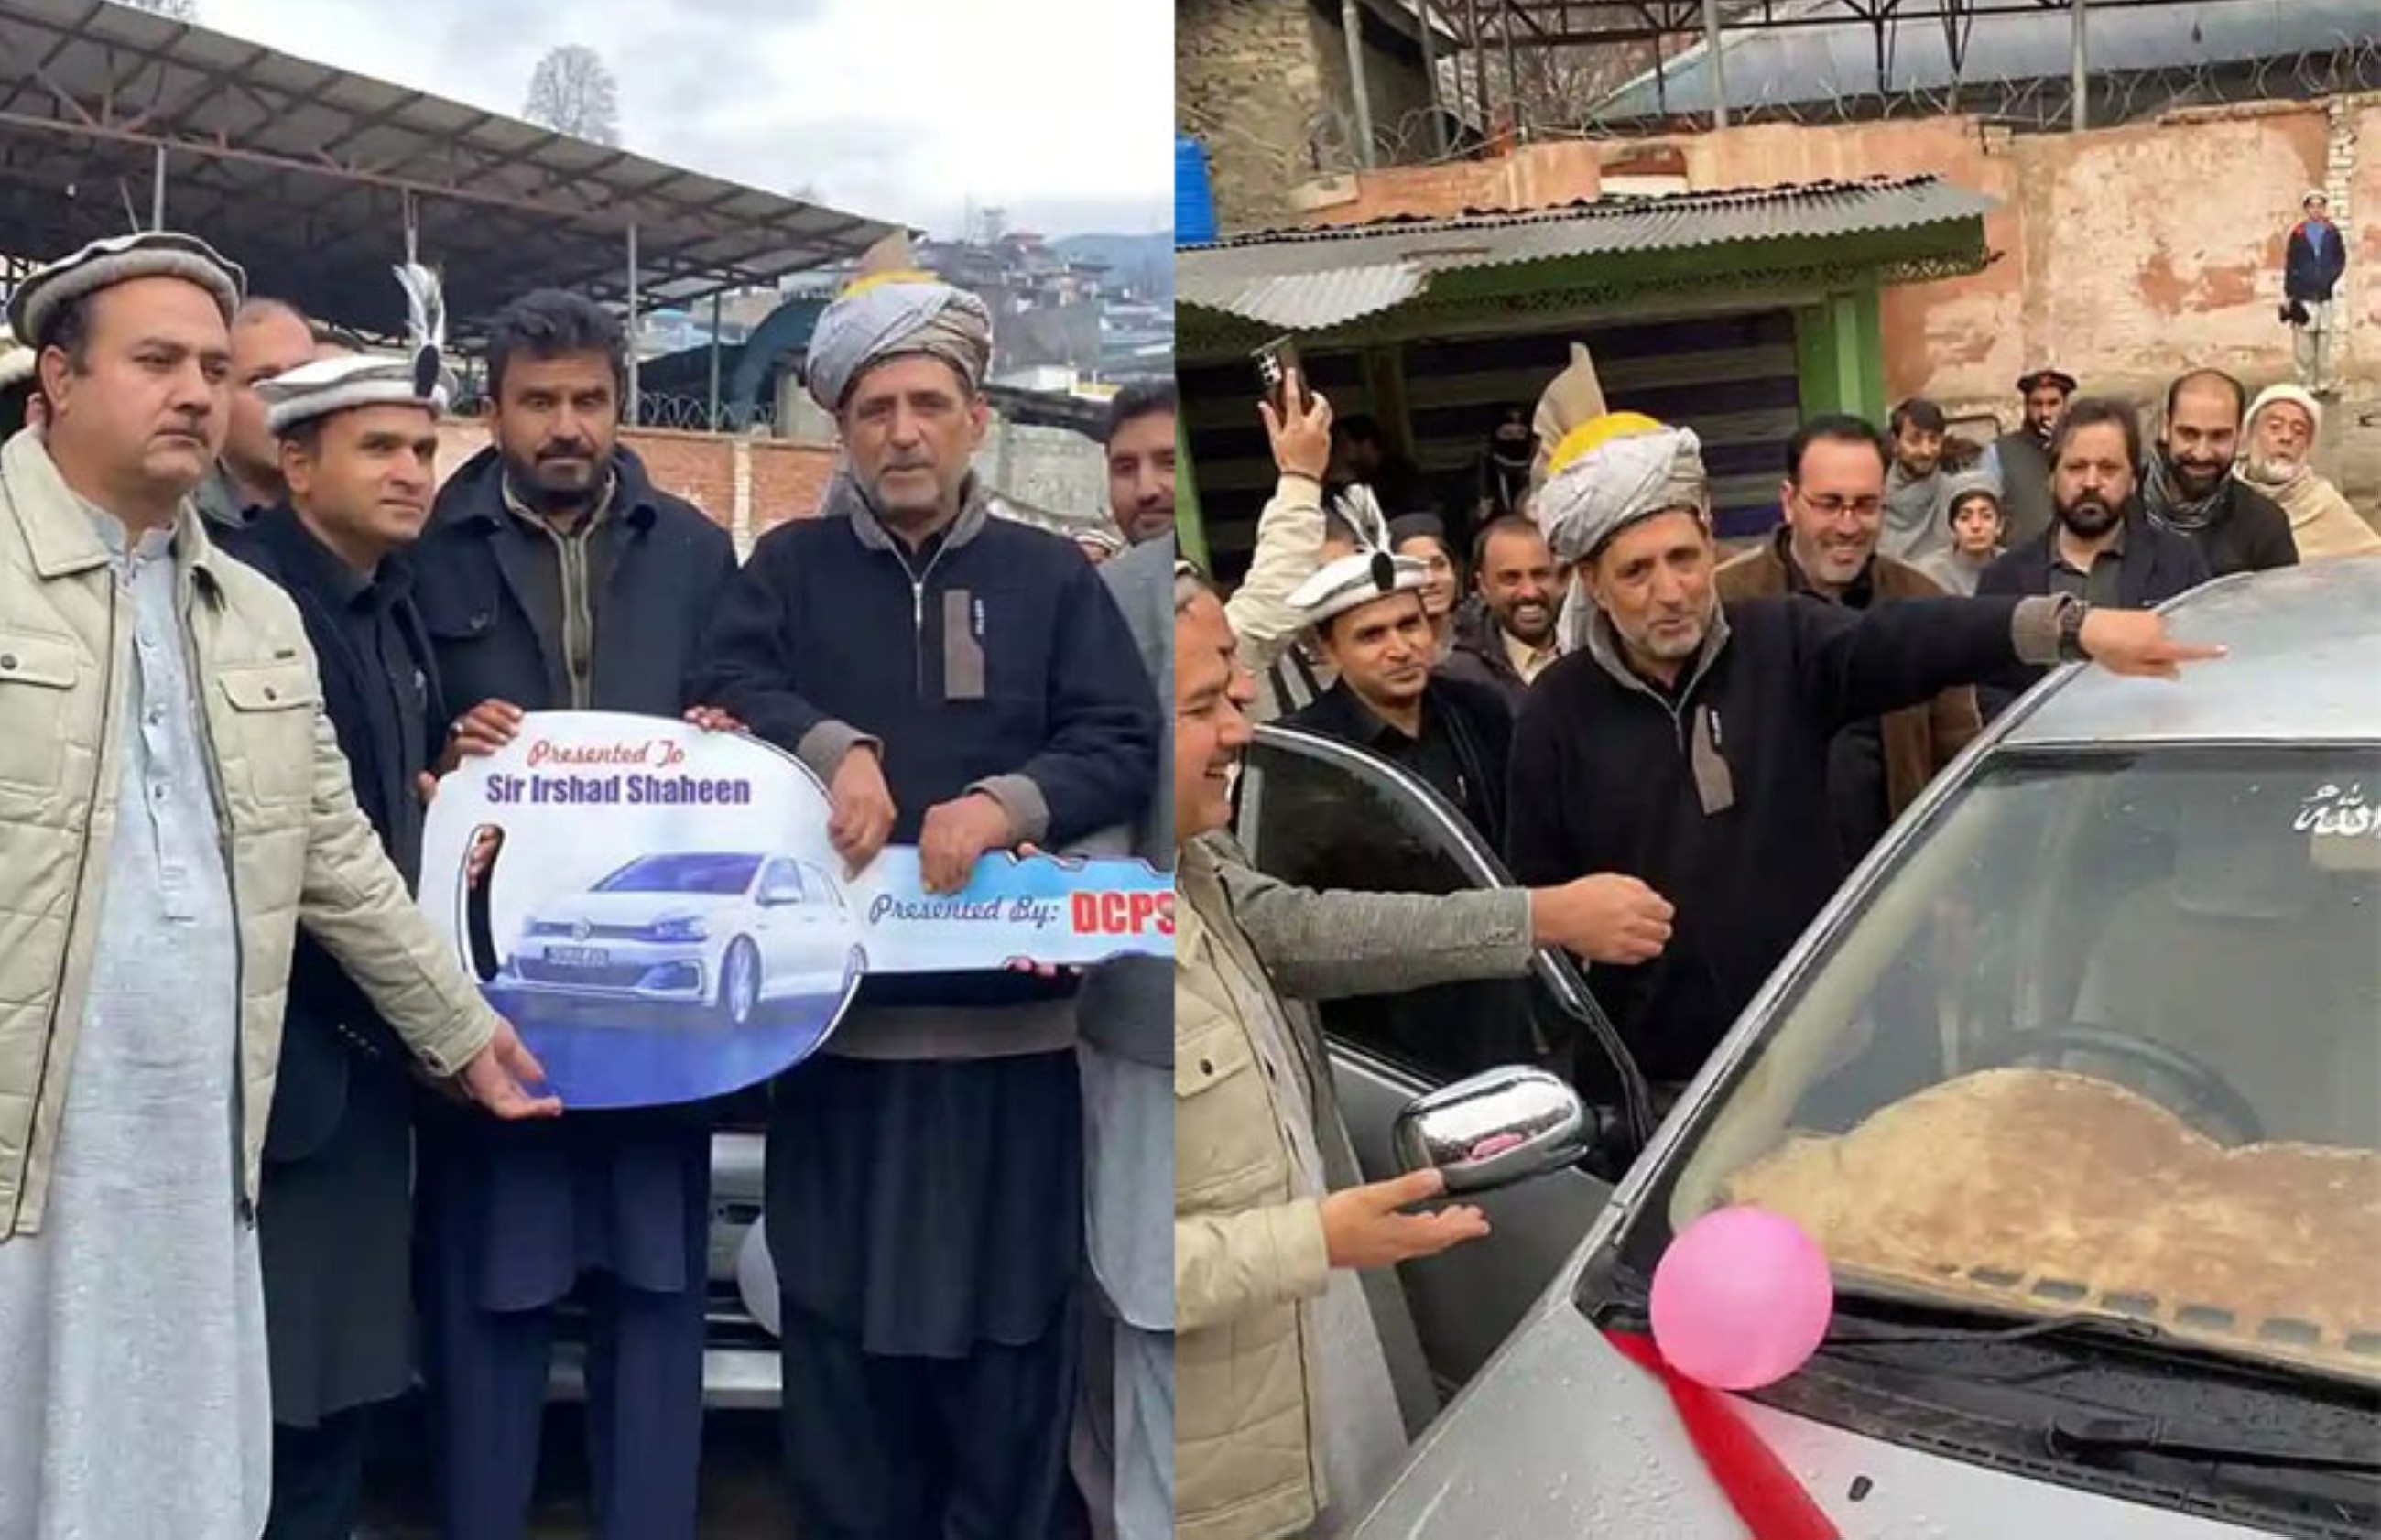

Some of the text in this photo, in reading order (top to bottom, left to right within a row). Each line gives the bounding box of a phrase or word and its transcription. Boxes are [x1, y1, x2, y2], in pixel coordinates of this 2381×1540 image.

[528, 740, 685, 767] Presented To
[486, 773, 751, 805] Sir Irshad Shaheen
[869, 892, 1175, 935] Presented By: DCPS
